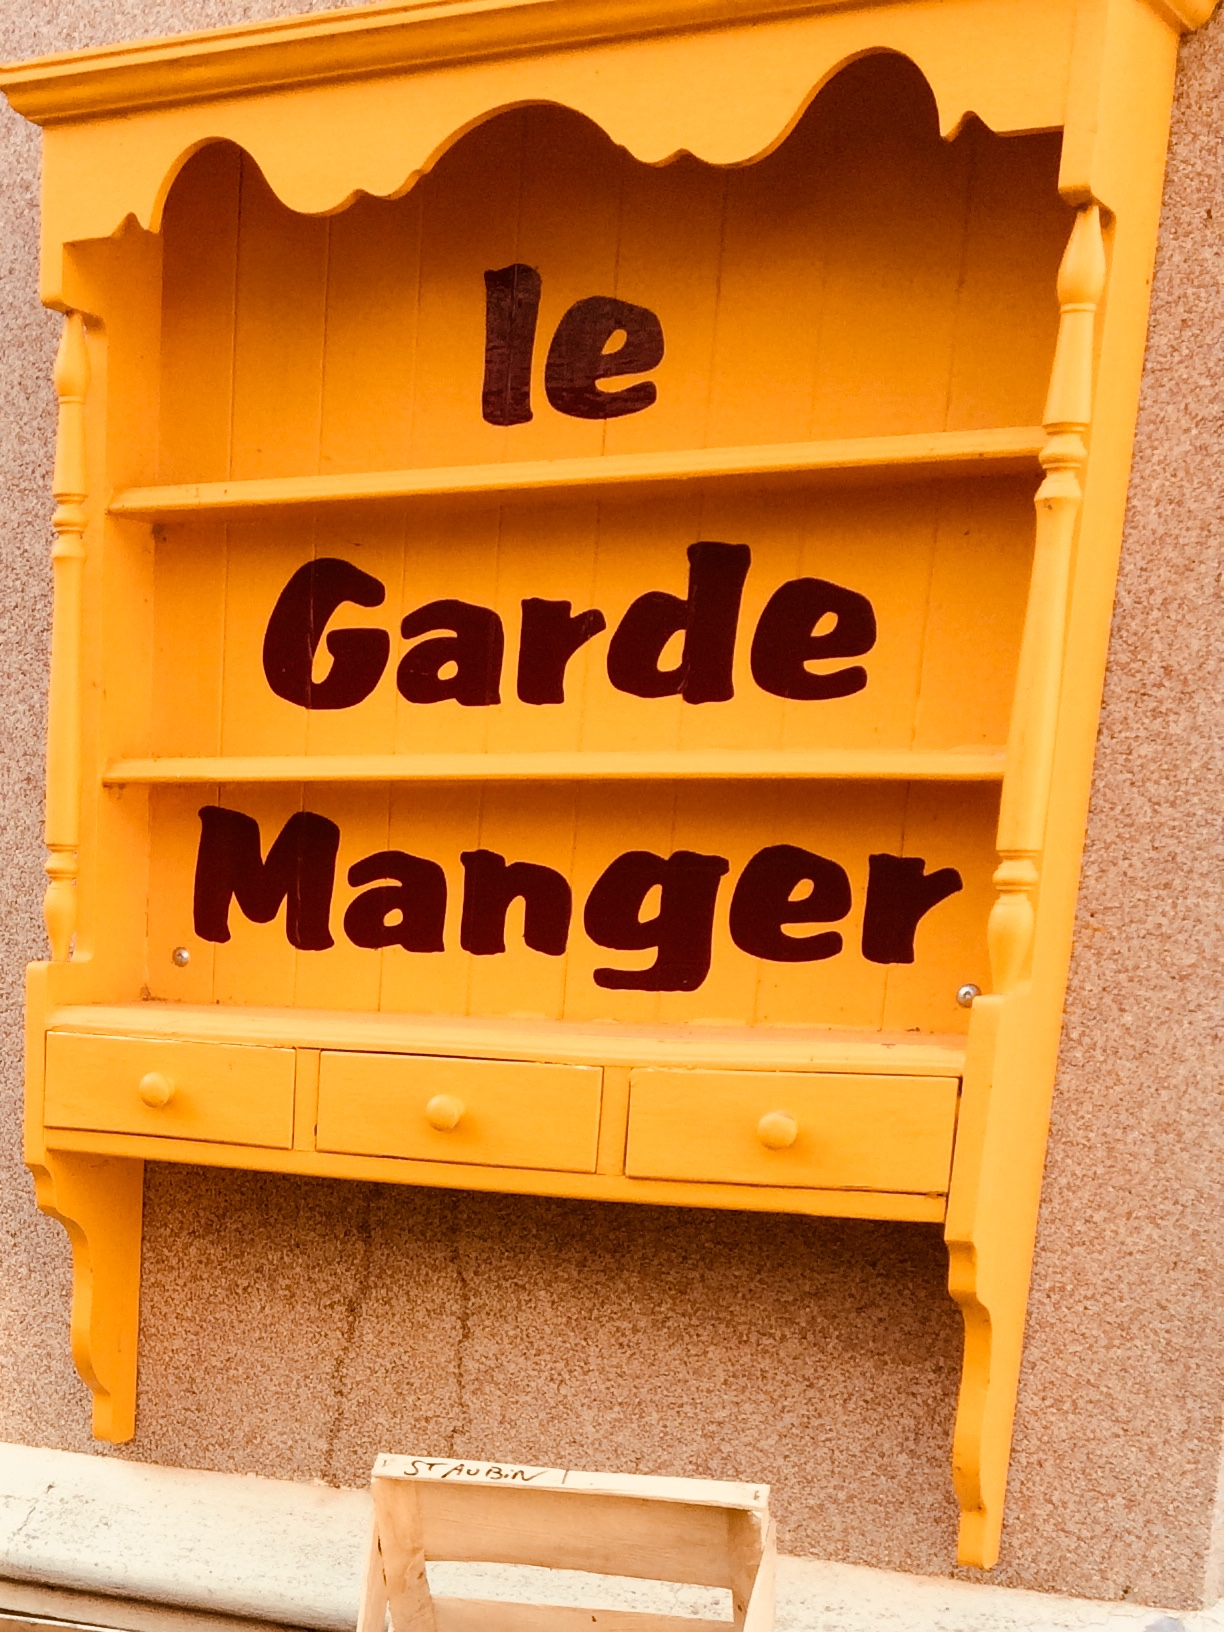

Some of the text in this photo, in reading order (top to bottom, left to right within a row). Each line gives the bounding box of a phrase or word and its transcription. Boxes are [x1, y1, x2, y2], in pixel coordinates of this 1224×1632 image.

[481, 263, 665, 427] le
[262, 541, 877, 711] Garde
[193, 804, 964, 992] Manger
